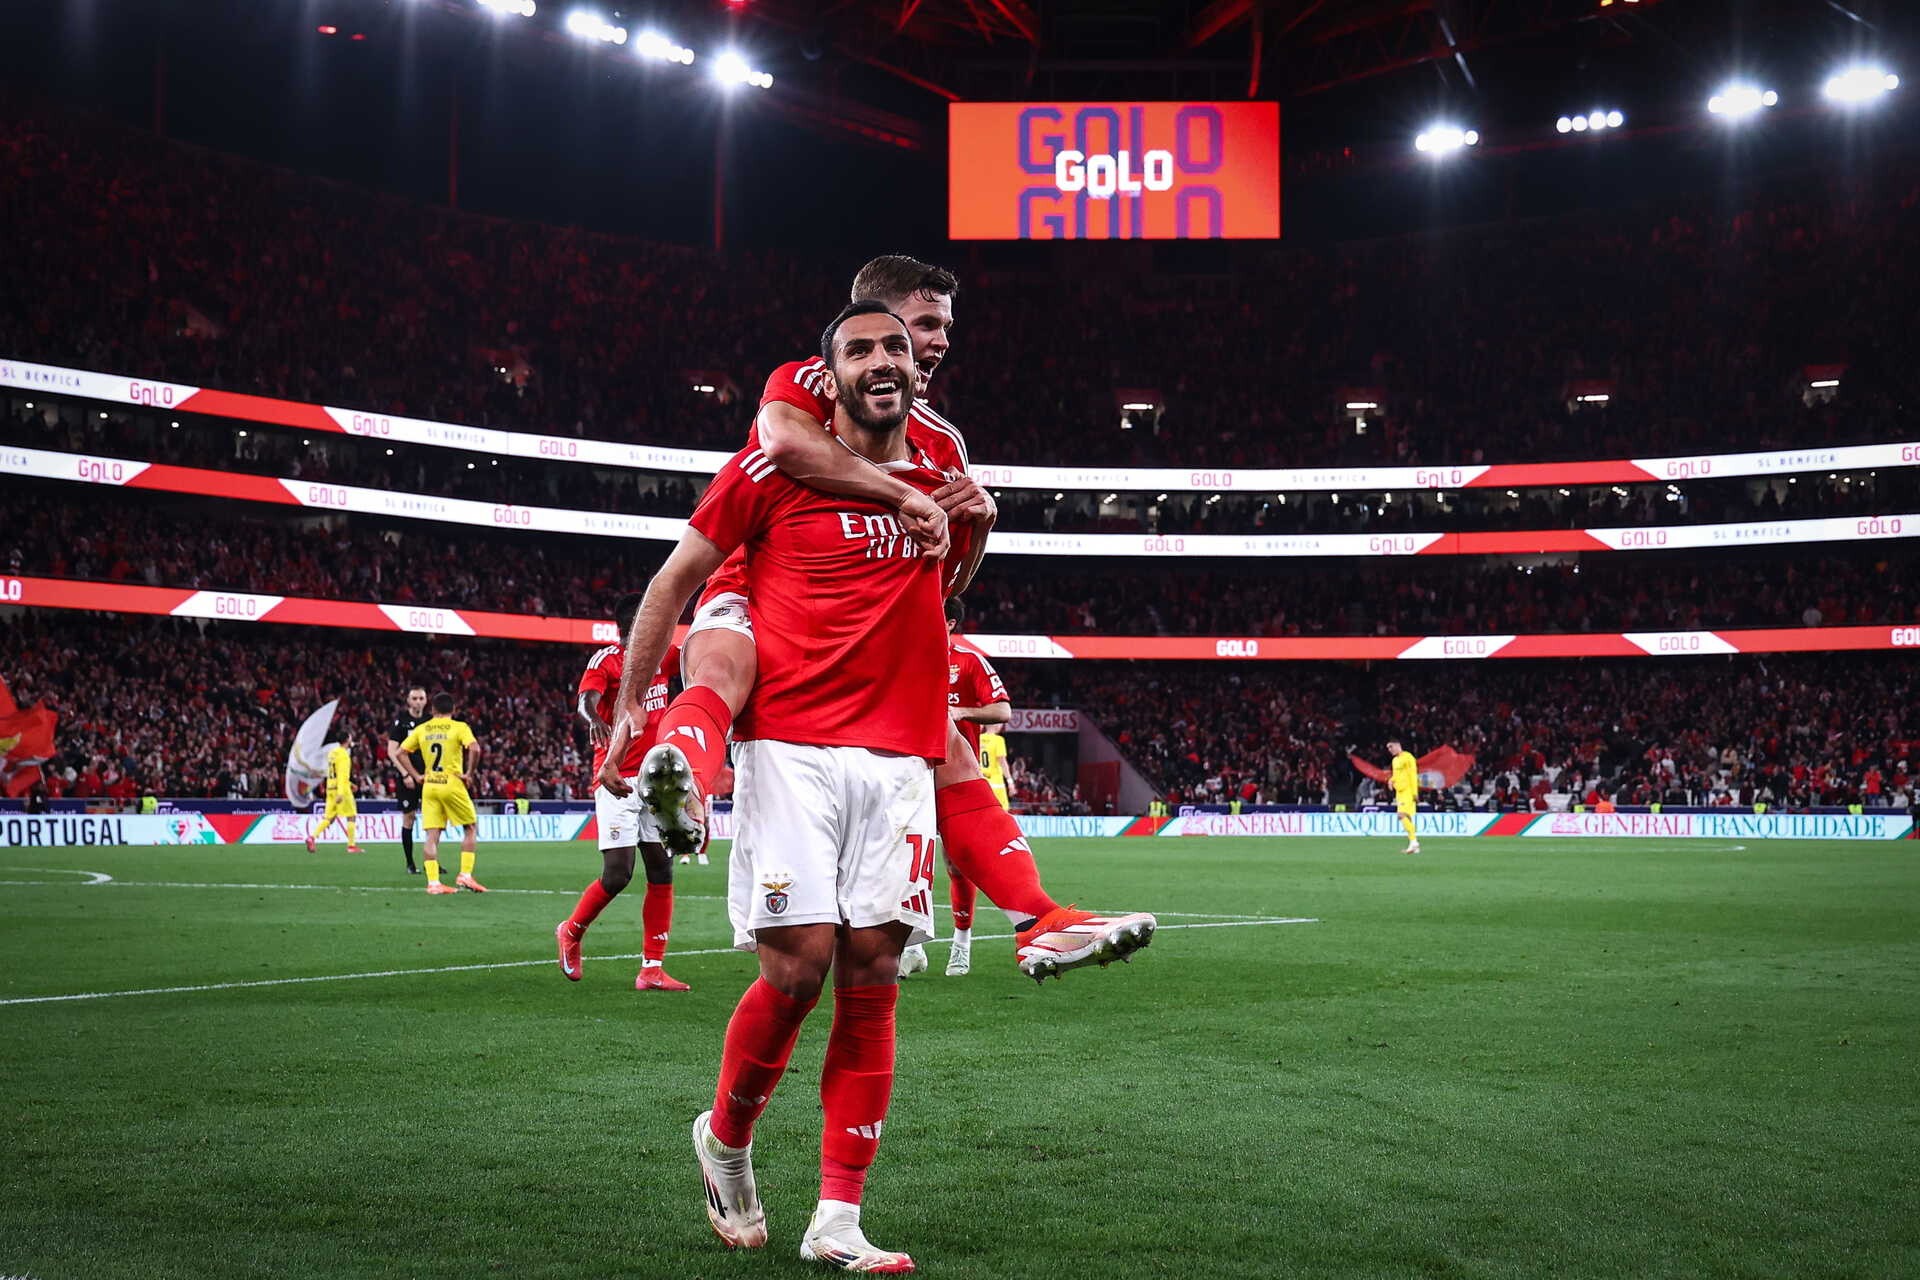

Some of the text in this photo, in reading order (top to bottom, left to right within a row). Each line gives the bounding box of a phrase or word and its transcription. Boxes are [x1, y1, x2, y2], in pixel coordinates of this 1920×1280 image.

[1055, 150, 1173, 199] GOLO
[130, 382, 174, 406] GOLO
[353, 414, 390, 437] GOLO
[539, 439, 577, 458] GOLO
[1902, 446, 1920, 462] GO
[78, 459, 122, 482] GOLO
[1667, 459, 1711, 479] GOLO
[1191, 472, 1232, 488] GOLO
[1416, 469, 1462, 489] GOLO
[309, 486, 347, 506] GOLO
[494, 508, 531, 525] GOLO
[1857, 519, 1902, 535] GOLO
[1144, 538, 1185, 552] GOLO
[1369, 537, 1415, 554] GOLO
[1621, 530, 1667, 546] GOLO
[0, 579, 22, 600] LO
[215, 596, 256, 617] GOLO
[409, 611, 444, 629] GOLO
[592, 623, 620, 642] GOL
[998, 640, 1037, 654] GOLO
[1215, 640, 1258, 657] GOLO
[1443, 640, 1486, 656] GOLO
[1659, 635, 1700, 651] GOLO
[1025, 711, 1078, 729] SAGRES
[430, 743, 443, 772] 2
[0, 818, 129, 846] ORTUGAL
[1210, 815, 1304, 834] GENERALI
[1585, 814, 1885, 839] GENERALI TRANQUILIDADE
[905, 834, 935, 892] 14
